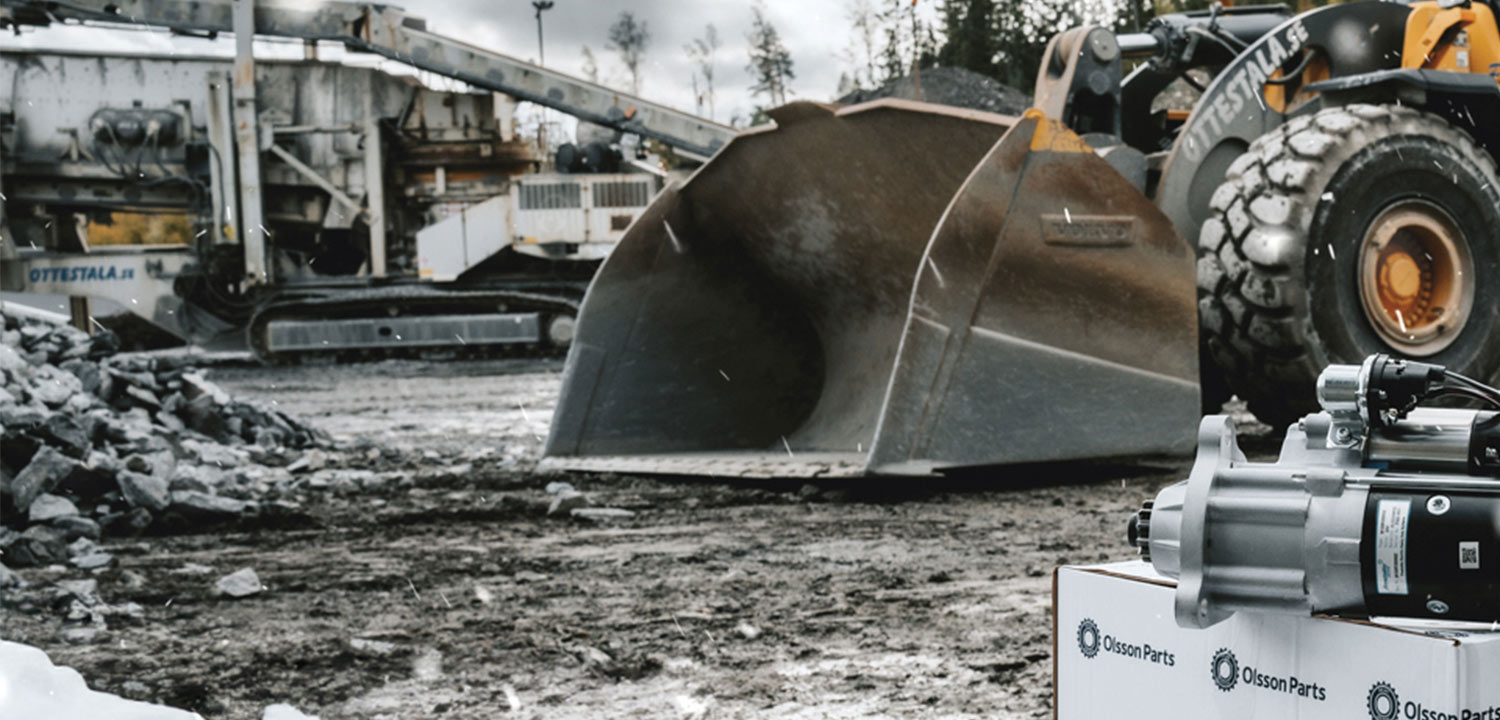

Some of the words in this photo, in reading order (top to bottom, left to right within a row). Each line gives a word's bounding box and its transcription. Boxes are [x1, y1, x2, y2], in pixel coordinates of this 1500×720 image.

[1182, 20, 1309, 162] OTTESTALA.SE
[1103, 634, 1142, 659] Olsson
[1143, 643, 1175, 667] Parts
[1242, 665, 1287, 693] Olsson
[1288, 676, 1327, 701] Parts
